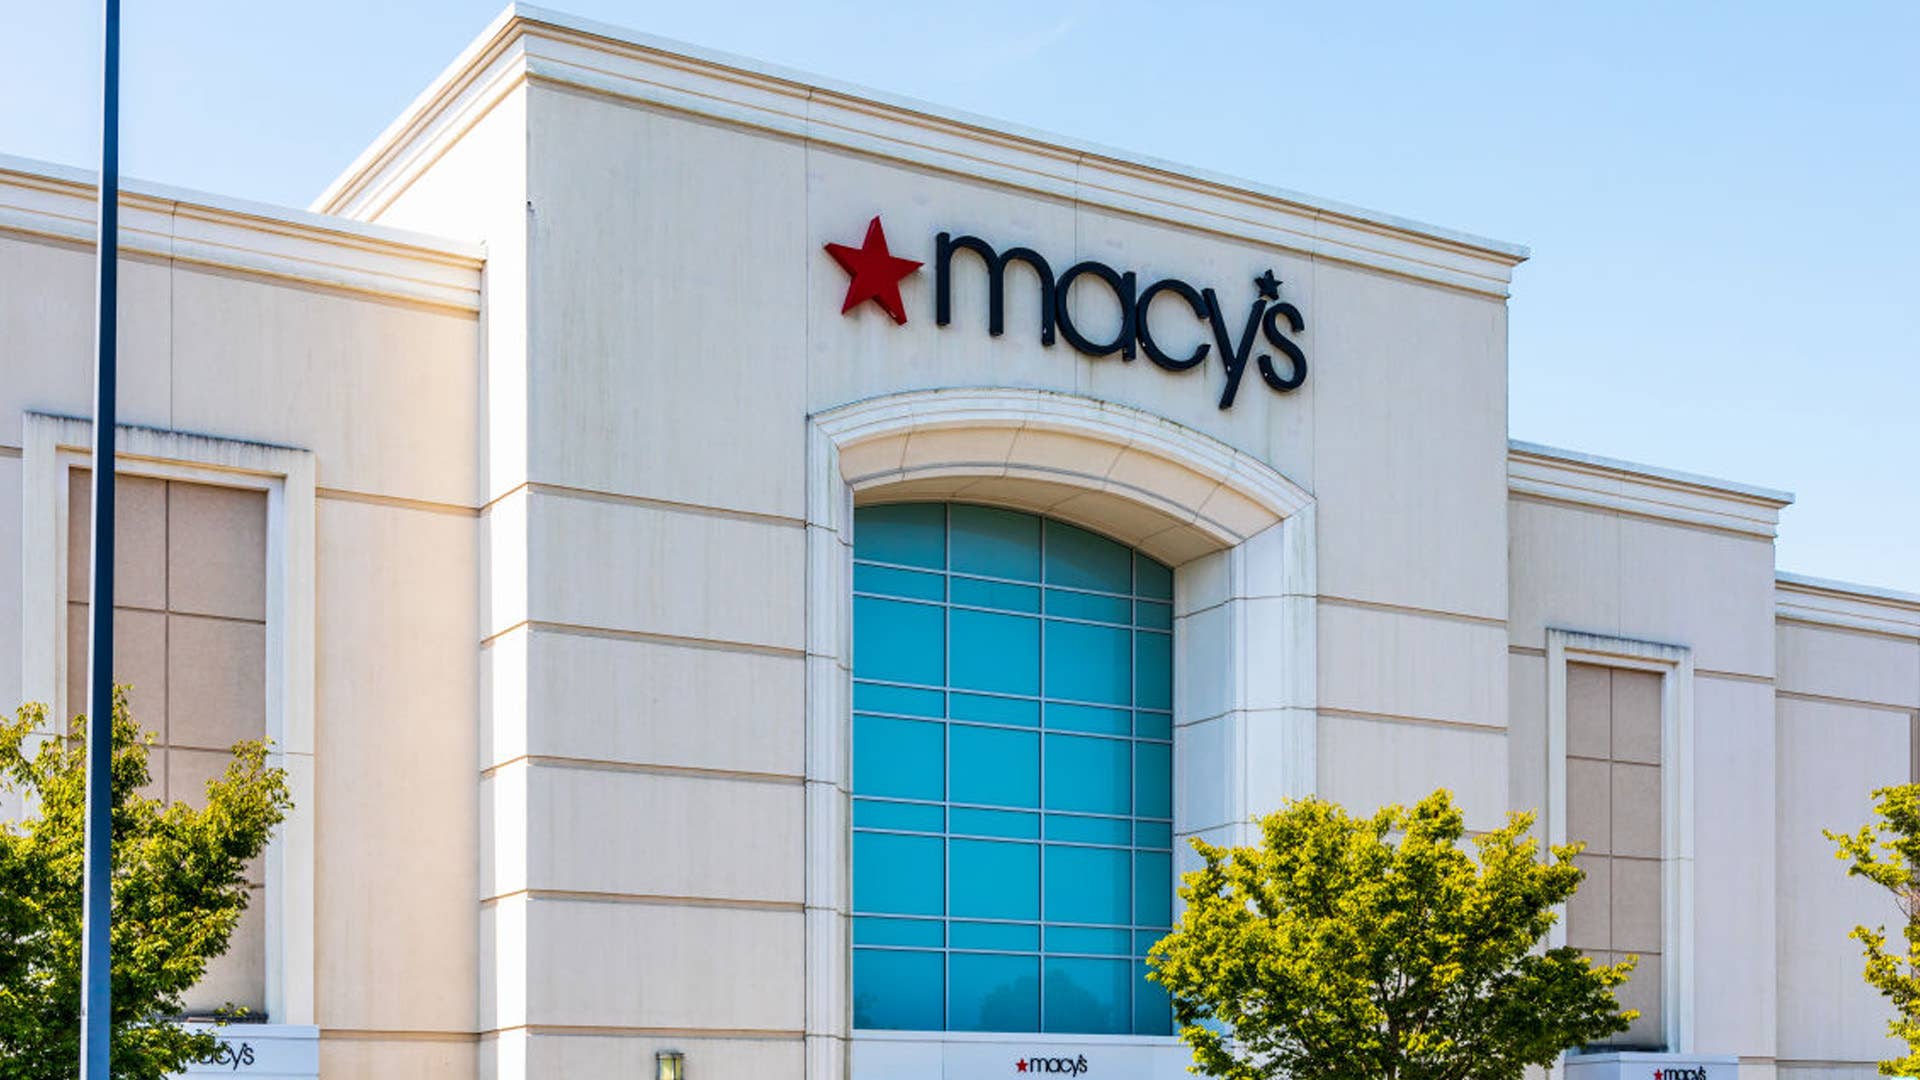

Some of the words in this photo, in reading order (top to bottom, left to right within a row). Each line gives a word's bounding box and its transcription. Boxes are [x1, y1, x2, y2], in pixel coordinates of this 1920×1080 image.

[936, 232, 1307, 409] macy's
[197, 1042, 255, 1070] cy's
[1030, 1054, 1088, 1077] macy's
